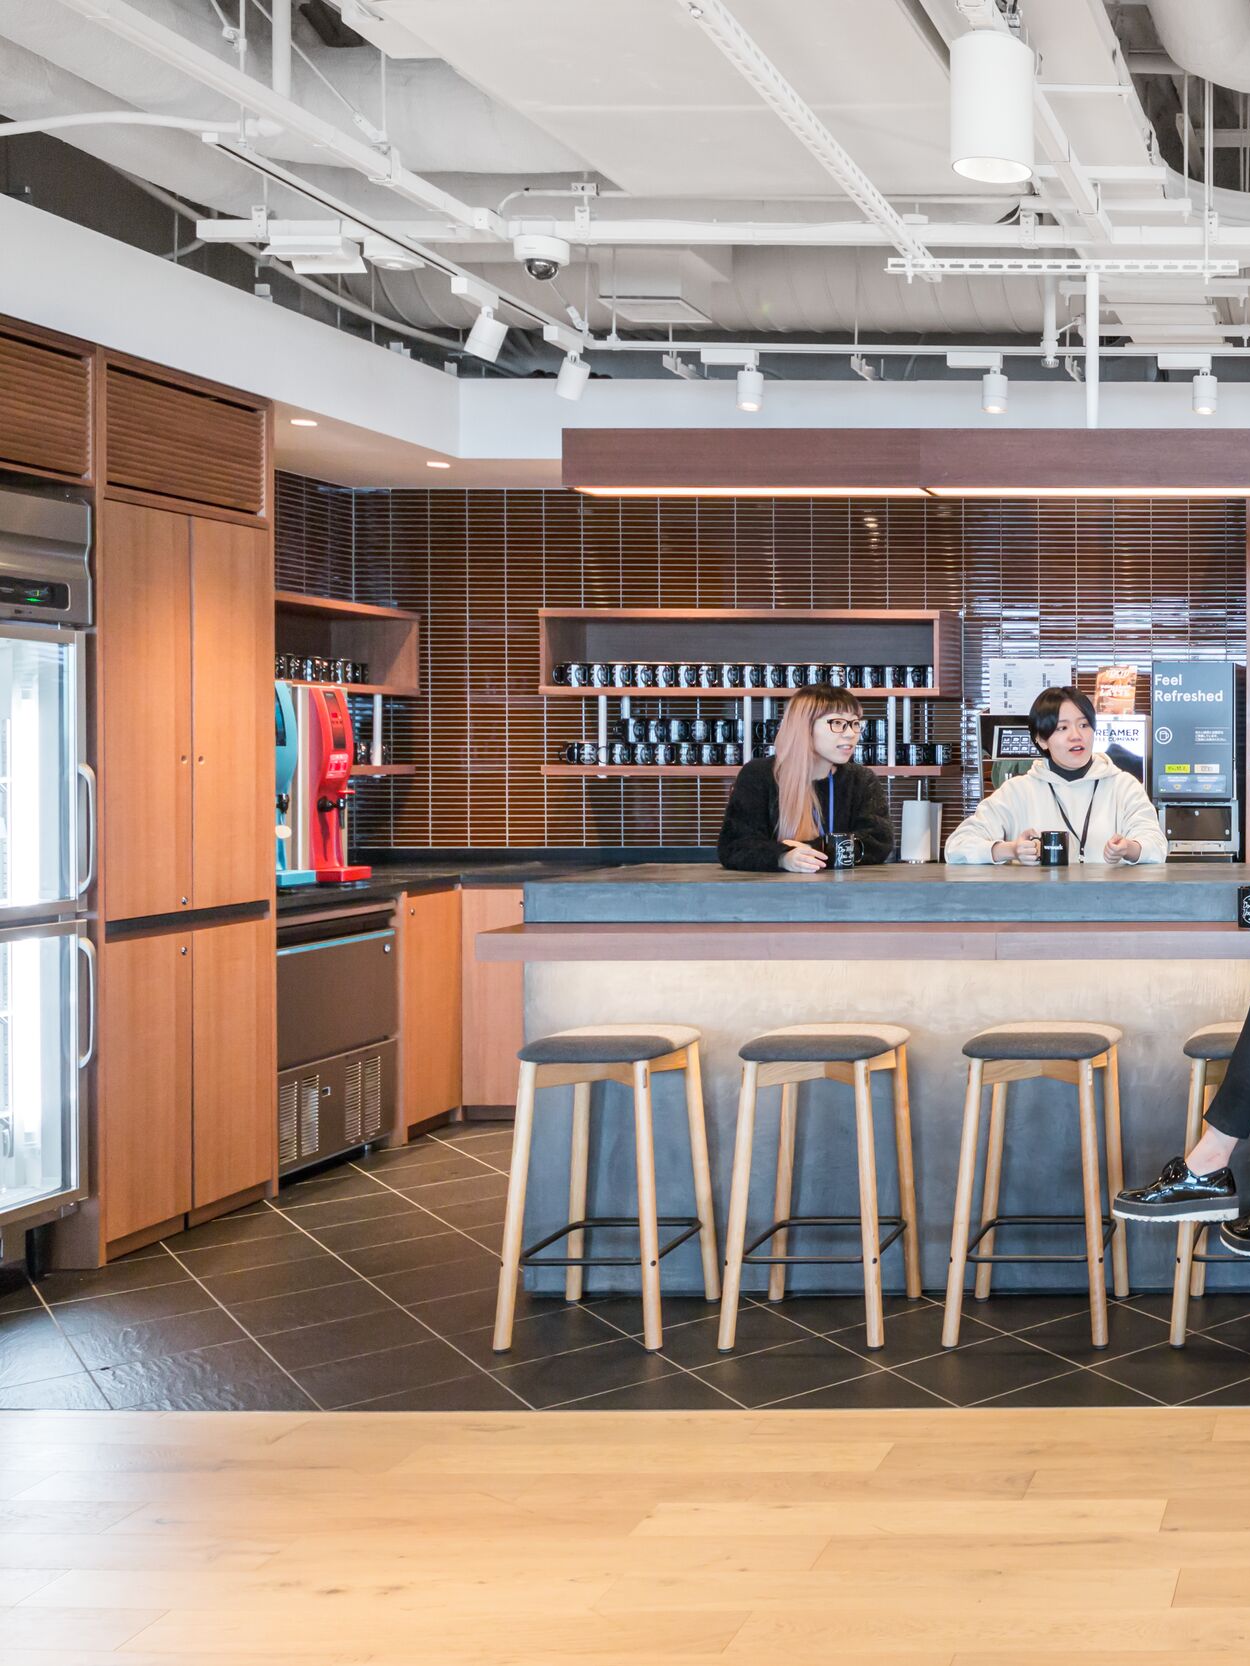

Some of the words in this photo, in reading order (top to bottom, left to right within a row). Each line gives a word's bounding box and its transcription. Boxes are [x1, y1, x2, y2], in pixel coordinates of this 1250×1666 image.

[1154, 674, 1182, 686] Feel
[1154, 690, 1224, 702] Refreshed
[1095, 729, 1140, 737] REAMER
